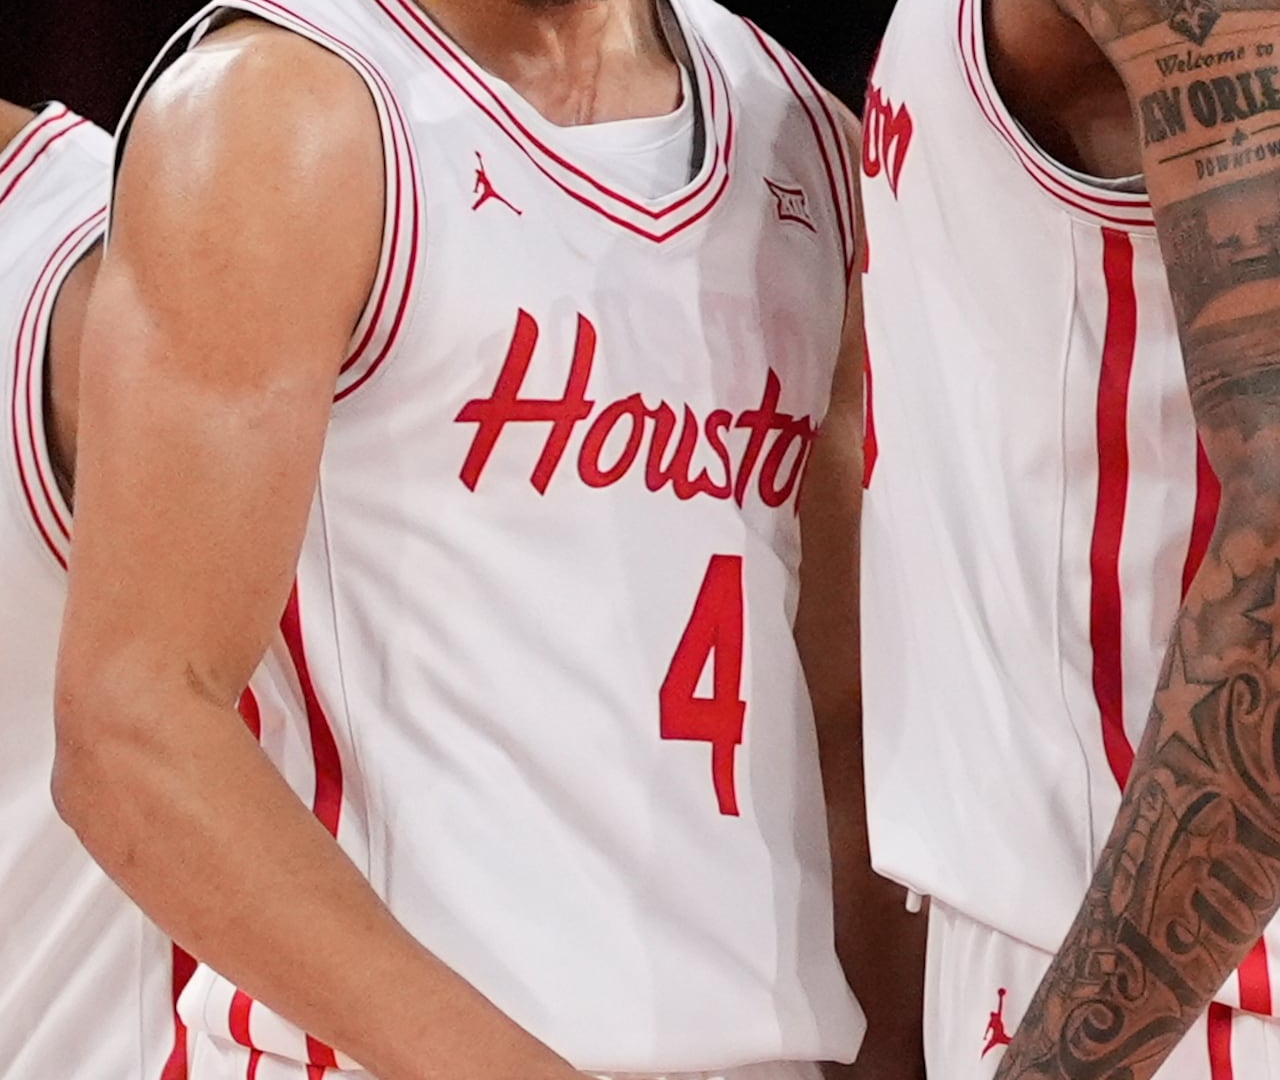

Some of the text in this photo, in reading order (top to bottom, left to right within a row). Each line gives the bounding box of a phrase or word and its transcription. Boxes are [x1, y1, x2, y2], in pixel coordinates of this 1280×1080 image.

[1155, 42, 1275, 78] Welcome to
[657, 553, 746, 817] 4
